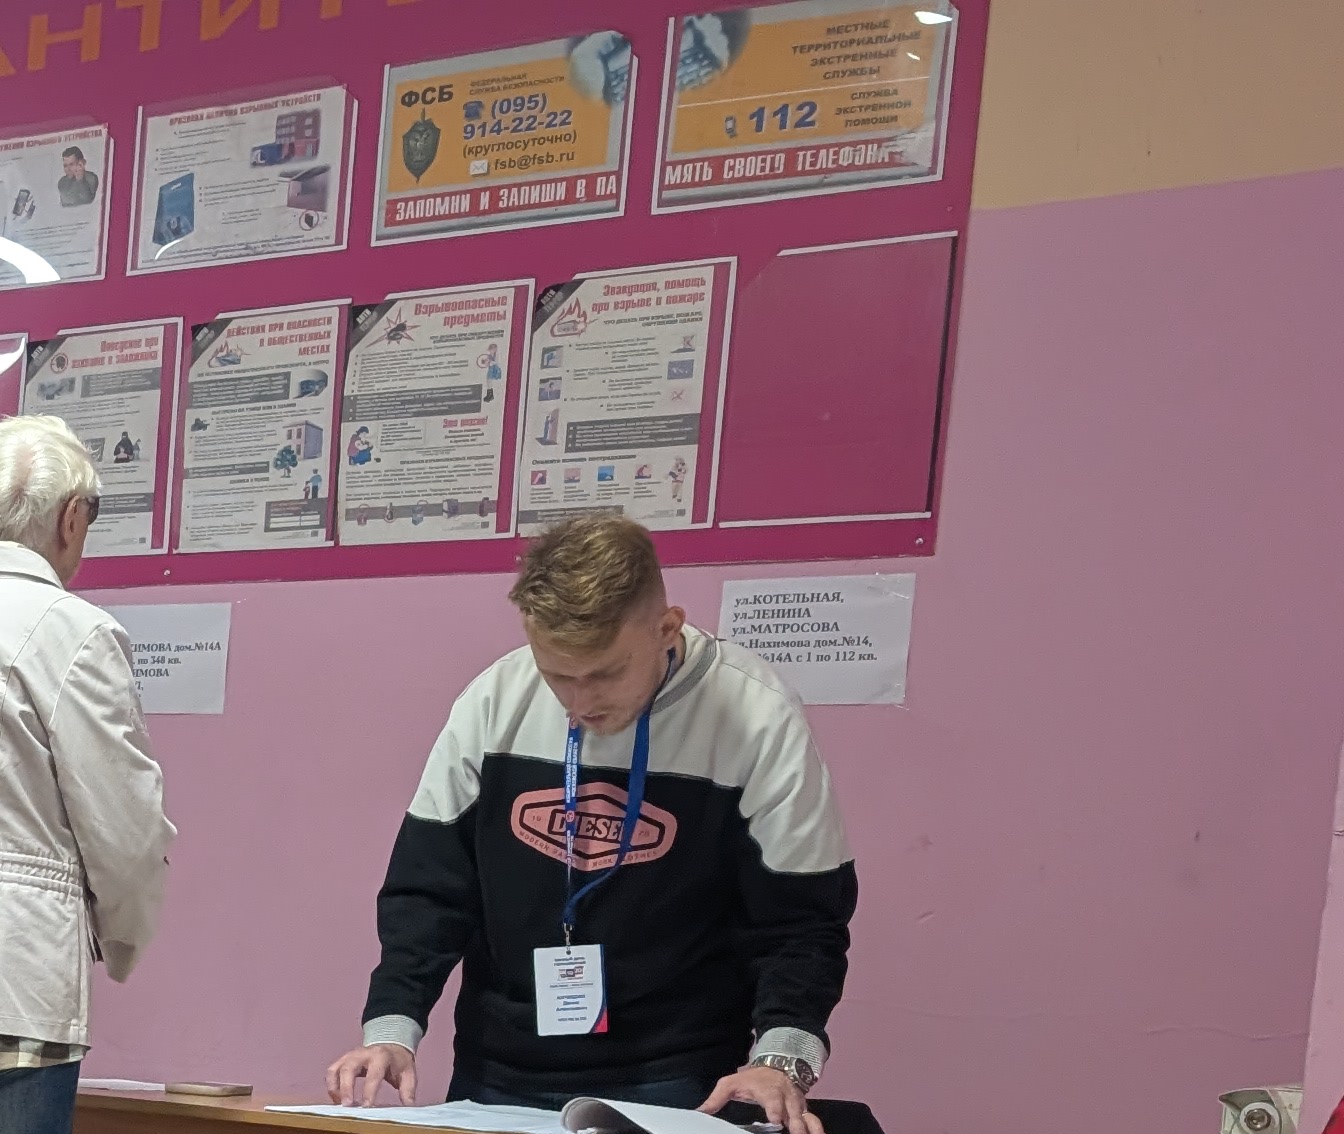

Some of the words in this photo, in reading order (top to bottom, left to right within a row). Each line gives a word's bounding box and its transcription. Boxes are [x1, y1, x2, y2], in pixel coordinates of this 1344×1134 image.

[826, 19, 890, 36] МЕСТНЫЕ
[792, 30, 922, 55] ТЕРРИТОРИАЛЬНЫЕ
[810, 49, 898, 67] ЭКСТРЕННЫЕ
[823, 65, 880, 80] СЛУЖБЫ
[401, 84, 454, 108] ФСБ
[491, 93, 548, 119] (095)
[463, 109, 573, 140] 914-22-22
[749, 101, 818, 133] 112
[463, 130, 577, 158] (круглосуточно)
[494, 151, 575, 171] fsb@fsb.ru
[664, 161, 713, 186] МЯТЬ
[723, 152, 785, 179] СВОЕГО
[396, 193, 471, 221] ЗАПОМНИ
[480, 191, 490, 211] И
[499, 182, 566, 208] ЗАПИШИ
[576, 179, 585, 199] В
[596, 175, 617, 196] ПА
[414, 296, 508, 317] Взрывоопасные
[443, 310, 507, 329] предметы
[734, 591, 844, 606] ул.КОТЕЛЬНАЯ,
[733, 608, 811, 622] ул.ЛЕНИНА
[731, 622, 840, 637] ул.МАТРОСОВА
[813, 635, 872, 649] дом.№14,
[151, 655, 165, 664] 348
[796, 654, 802, 663] с
[807, 652, 811, 662] 1
[816, 654, 831, 662] по
[835, 651, 855, 661] 112
[858, 652, 877, 661] кв.
[553, 812, 625, 841] DESE
